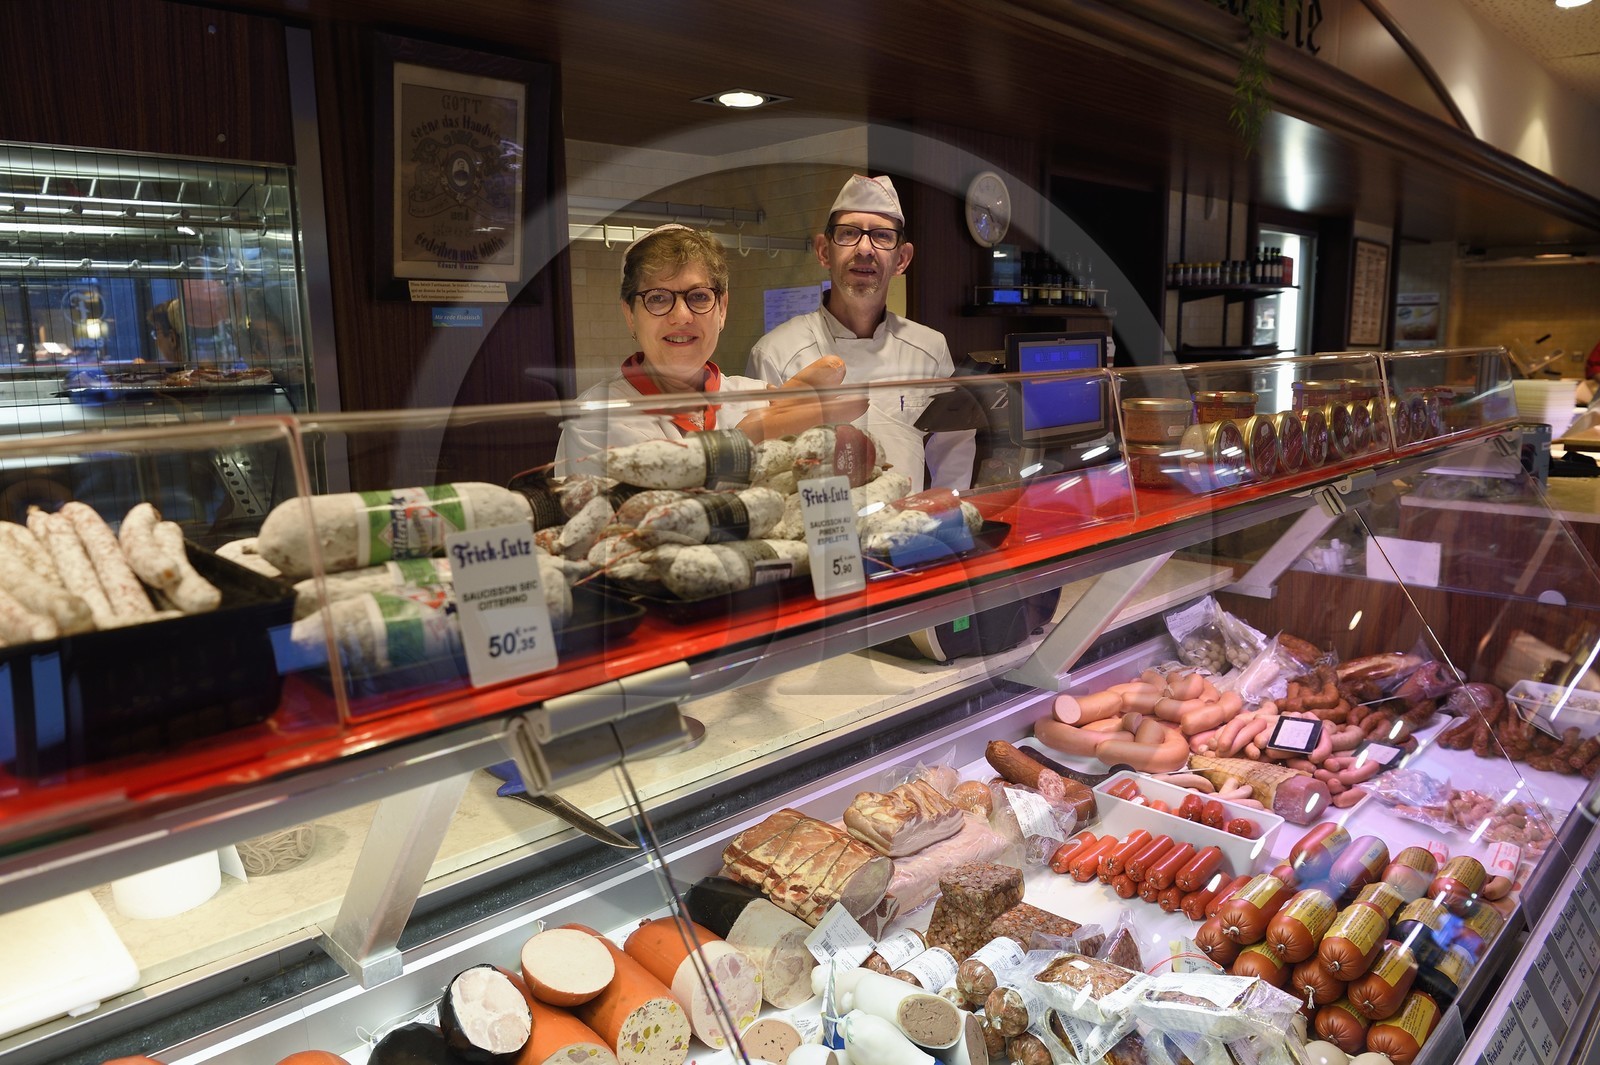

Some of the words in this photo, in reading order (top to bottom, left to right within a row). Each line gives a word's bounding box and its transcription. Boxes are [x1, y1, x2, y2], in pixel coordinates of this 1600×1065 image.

[441, 94, 483, 115] GOTT
[442, 114, 459, 128] das
[845, 442, 853, 475] LOSTE
[802, 486, 849, 507] Frick-Lutz
[810, 519, 842, 529] SAUCISSON
[452, 536, 532, 569] Frick-Lutz
[462, 585, 518, 603] SAUCISSON
[519, 579, 539, 592] SEC
